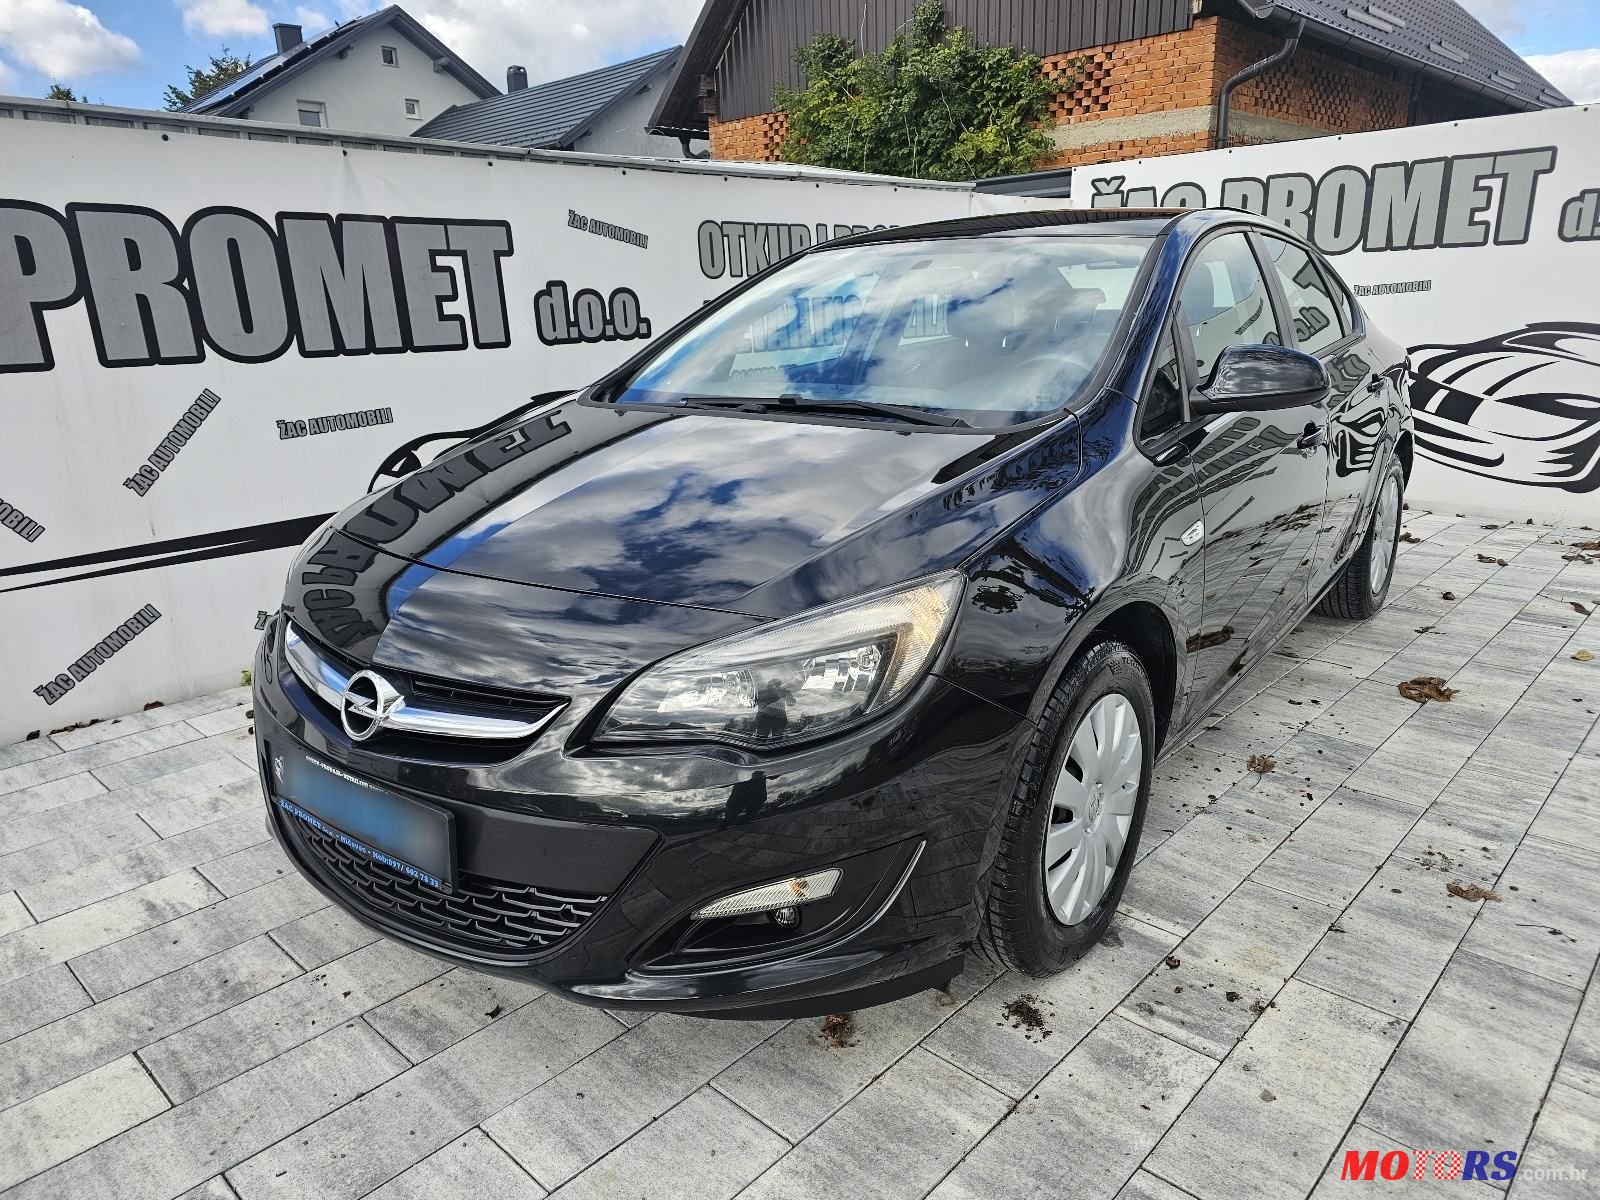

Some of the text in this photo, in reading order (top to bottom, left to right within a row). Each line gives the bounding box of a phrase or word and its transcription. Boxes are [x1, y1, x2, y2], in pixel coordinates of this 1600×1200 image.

[568, 209, 649, 249] ŽAC AUTOMOBILI
[0, 199, 651, 374] PROMET d.o.o.
[1372, 279, 1431, 295] AUTOMOBILI
[122, 388, 221, 497] ŽAC AUTOMOBILI
[275, 407, 394, 440] ŽAC AUTOMOBILI
[0, 498, 46, 543] OBILI
[33, 603, 162, 706] ŽAC AUTOMOBILI
